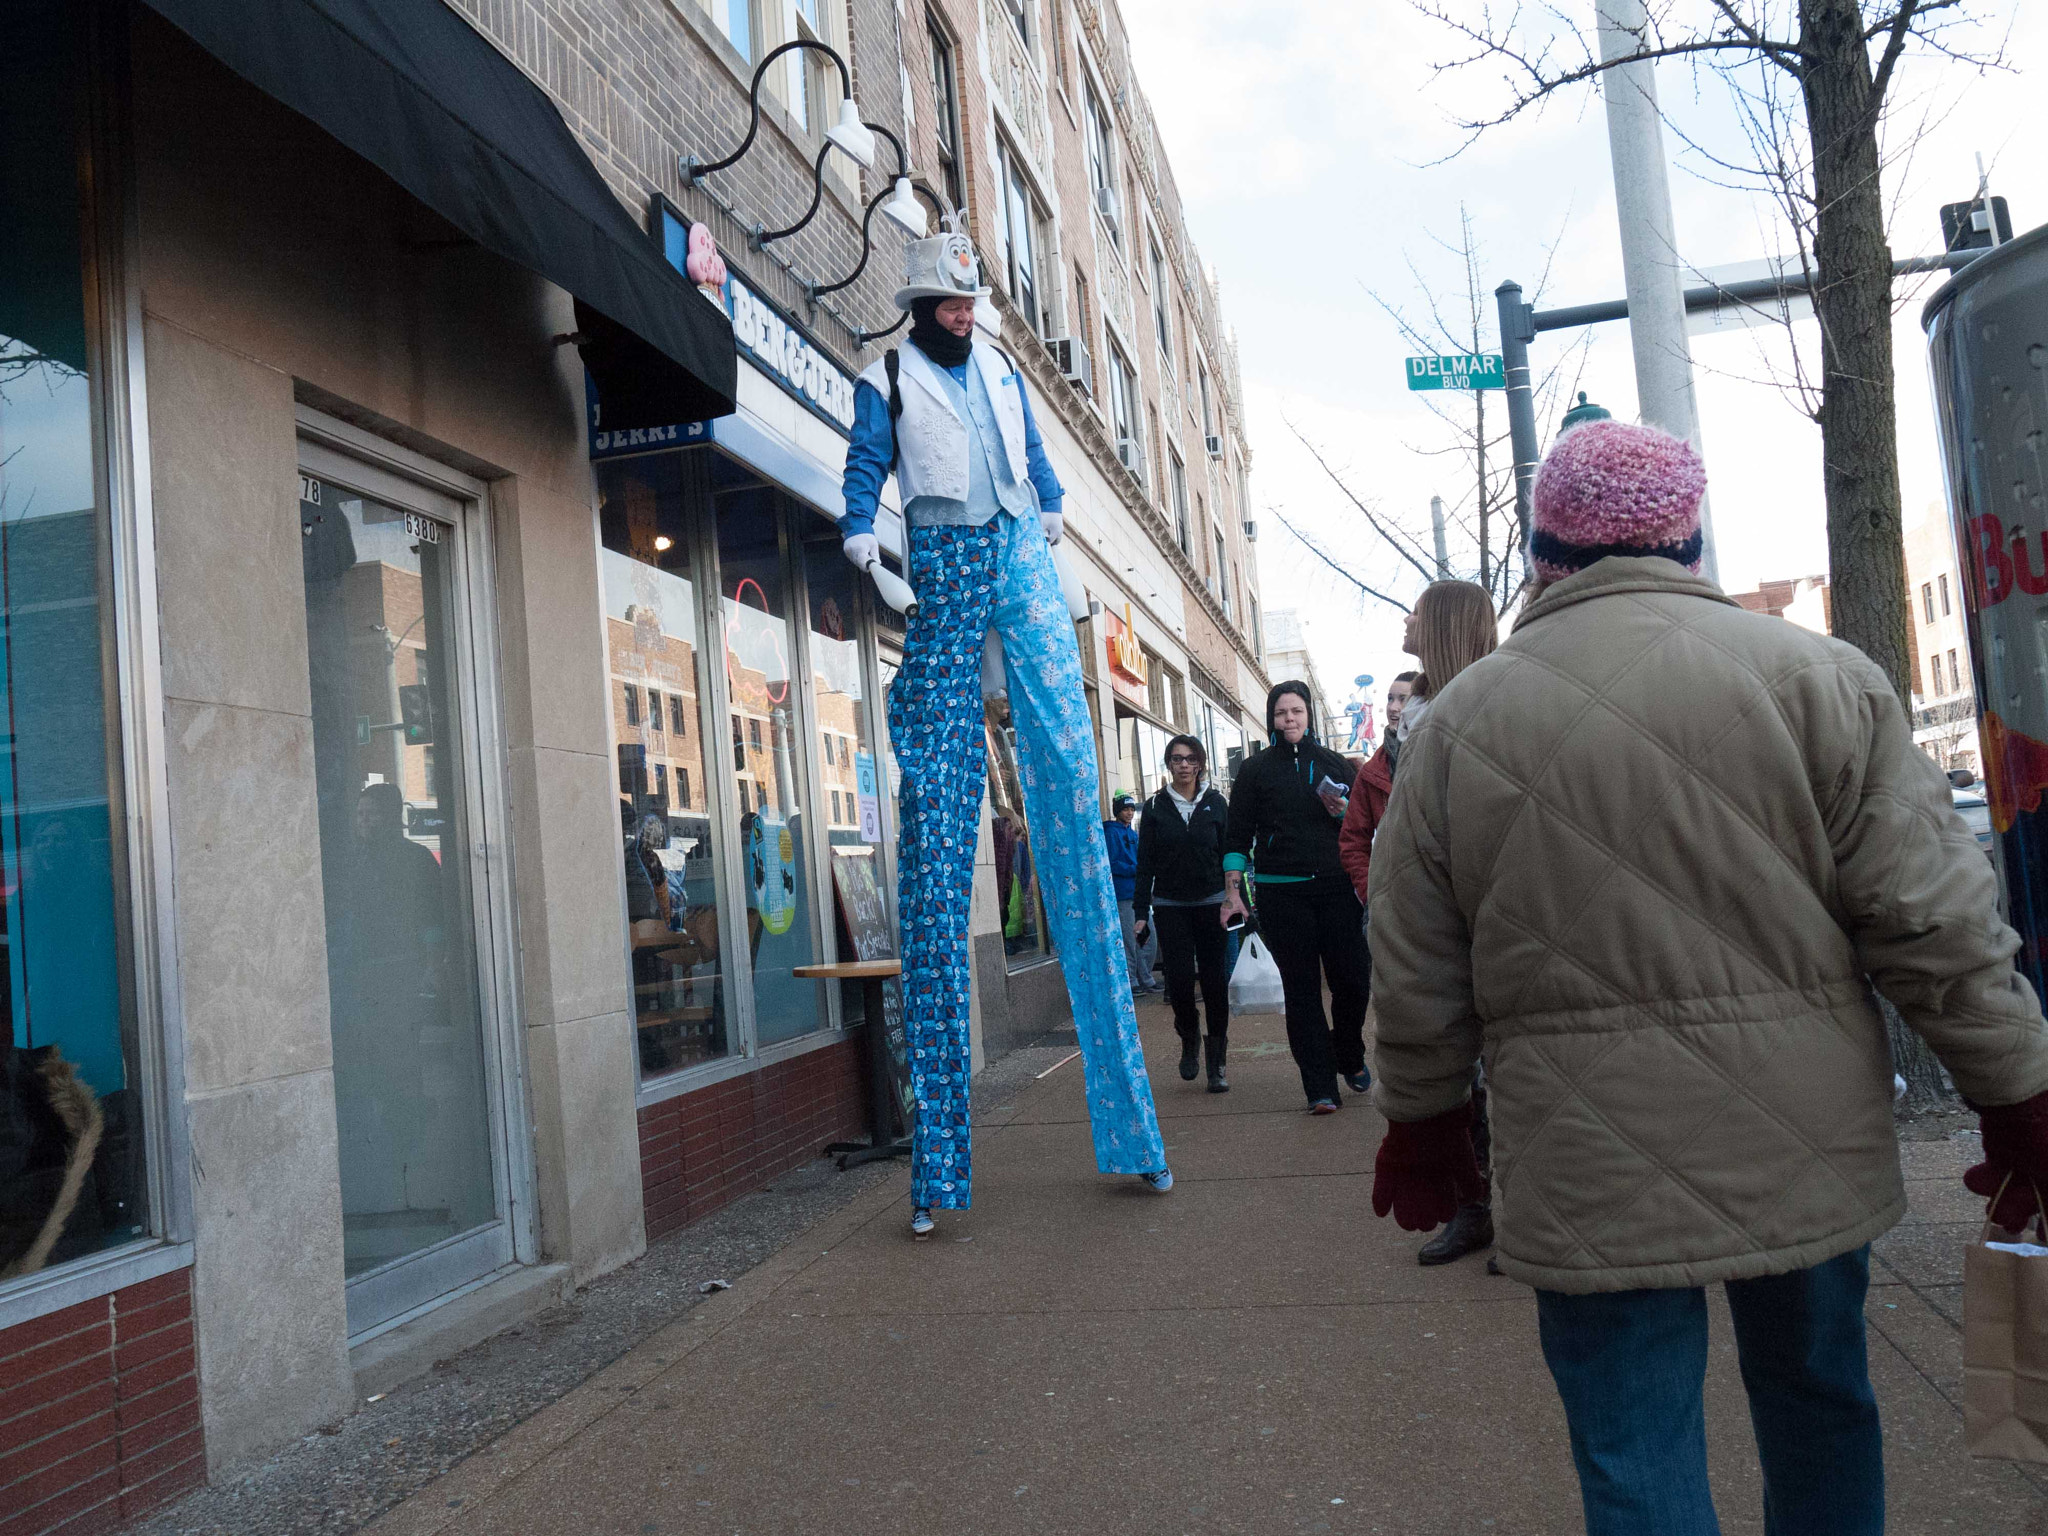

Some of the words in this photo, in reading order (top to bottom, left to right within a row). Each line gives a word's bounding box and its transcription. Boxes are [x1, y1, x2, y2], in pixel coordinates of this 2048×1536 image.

[1412, 357, 1496, 376] DELMAR
[1443, 376, 1470, 388] BLVD
[302, 476, 319, 503] 78
